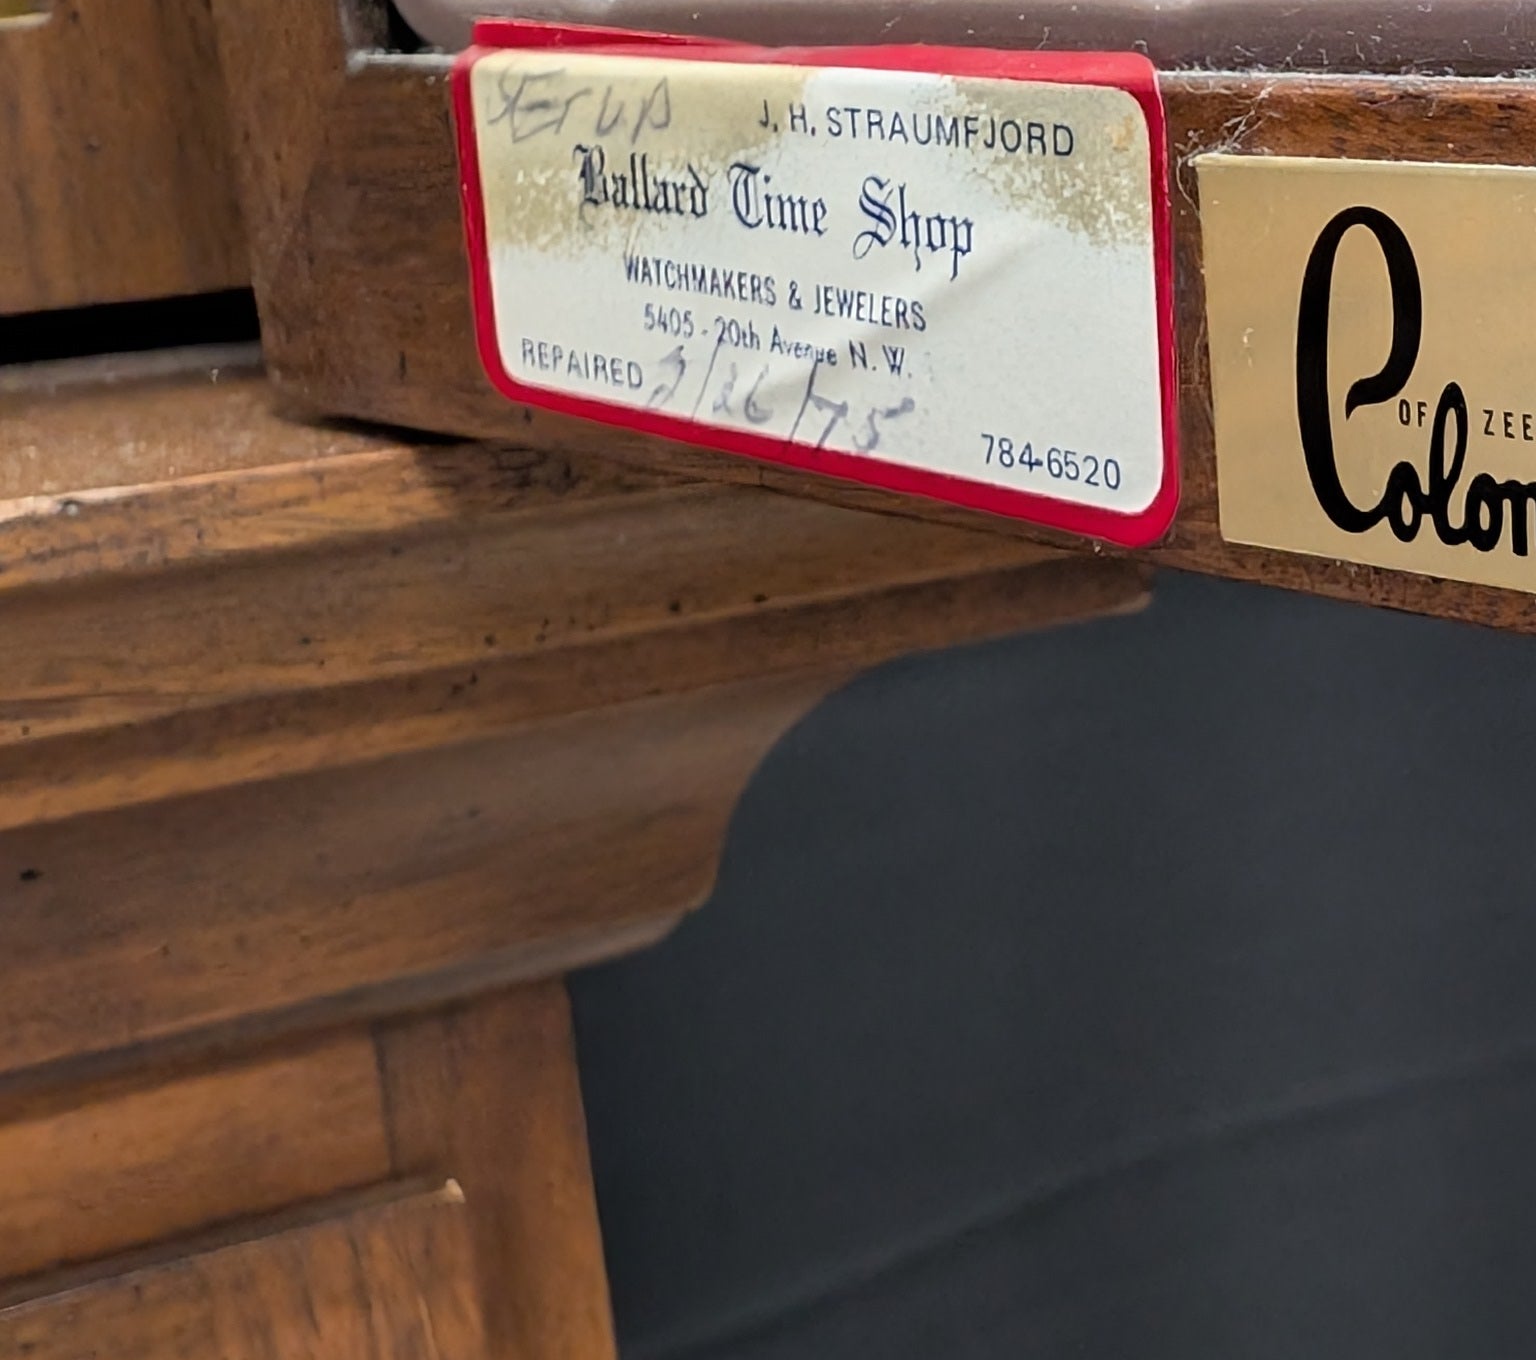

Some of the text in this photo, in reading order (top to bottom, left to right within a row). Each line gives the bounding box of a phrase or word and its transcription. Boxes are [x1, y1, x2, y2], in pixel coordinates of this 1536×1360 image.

[757, 99, 1075, 157] J. H. STRAUMFJORD
[572, 144, 975, 282] Ballard Time Shop
[623, 253, 928, 332] WATCHMAKERS & JEWELERS
[521, 337, 644, 389] REPAIRED
[644, 303, 695, 339] 5405
[715, 316, 761, 351] 20th
[769, 324, 839, 366] Avenue
[1398, 397, 1429, 428] OF
[981, 432, 1121, 490] 784-6520
